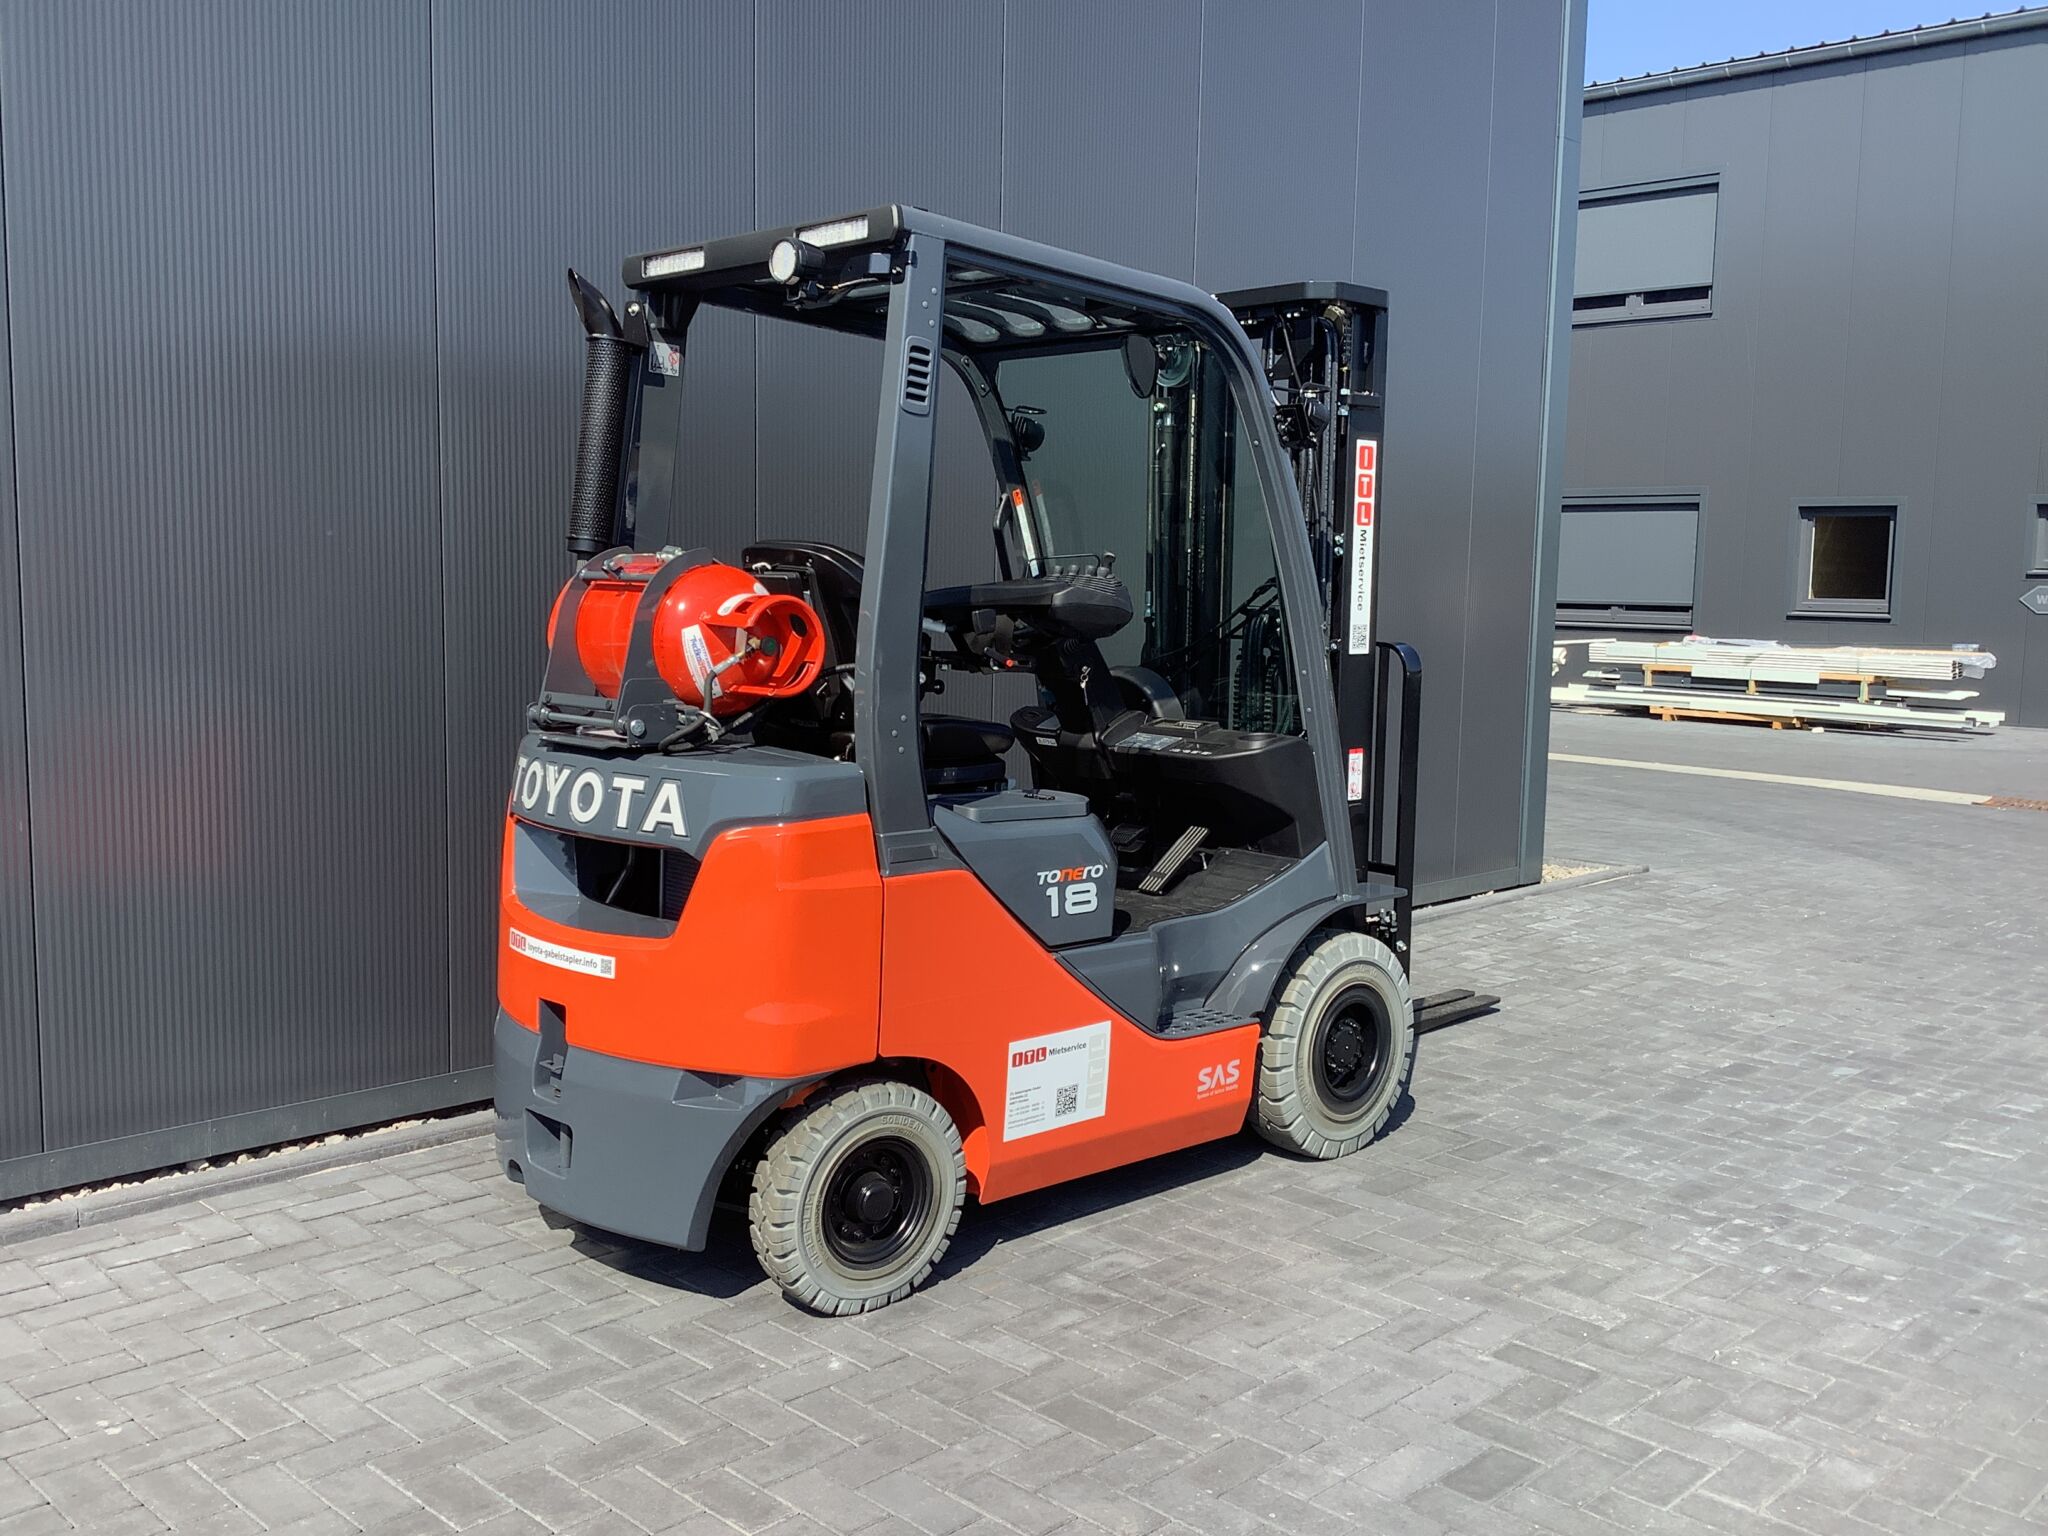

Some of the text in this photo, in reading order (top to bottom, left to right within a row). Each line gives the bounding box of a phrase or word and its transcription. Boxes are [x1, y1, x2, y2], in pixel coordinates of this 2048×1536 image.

[1357, 447, 1371, 611] ITL Mietservice
[513, 757, 688, 836] TOYOTA
[1046, 882, 1098, 917] 18
[1013, 1041, 1087, 1067] ITL Mietservice
[1197, 1059, 1240, 1092] SAS
